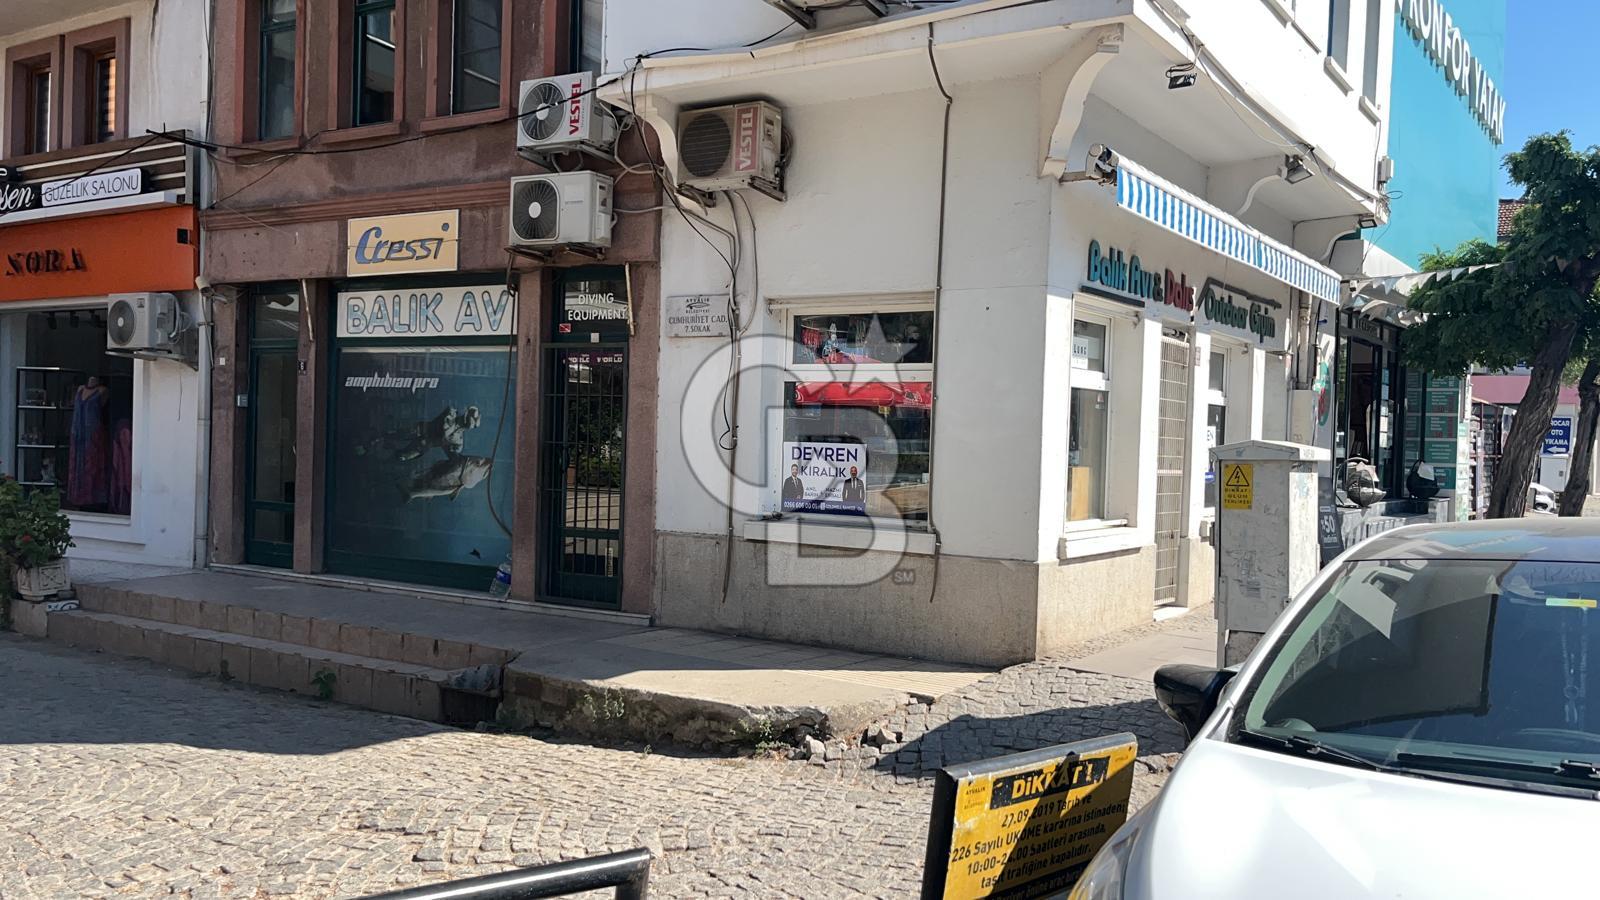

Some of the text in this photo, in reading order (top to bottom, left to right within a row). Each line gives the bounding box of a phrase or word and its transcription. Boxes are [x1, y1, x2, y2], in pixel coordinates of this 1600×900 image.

[569, 79, 582, 135] VESTEL
[1474, 56, 1506, 145] YATAK
[738, 111, 754, 169] VESTEL
[92, 174, 139, 196] SALONU
[354, 222, 450, 264] Cressi
[6, 247, 88, 276] NORA
[346, 292, 444, 334] BALIK
[578, 292, 614, 304] DIVING
[1204, 287, 1276, 344] Outdoor Giyim
[345, 371, 440, 394] amphibian pro
[791, 446, 858, 462] DEVREN
[951, 844, 971, 863] 226
